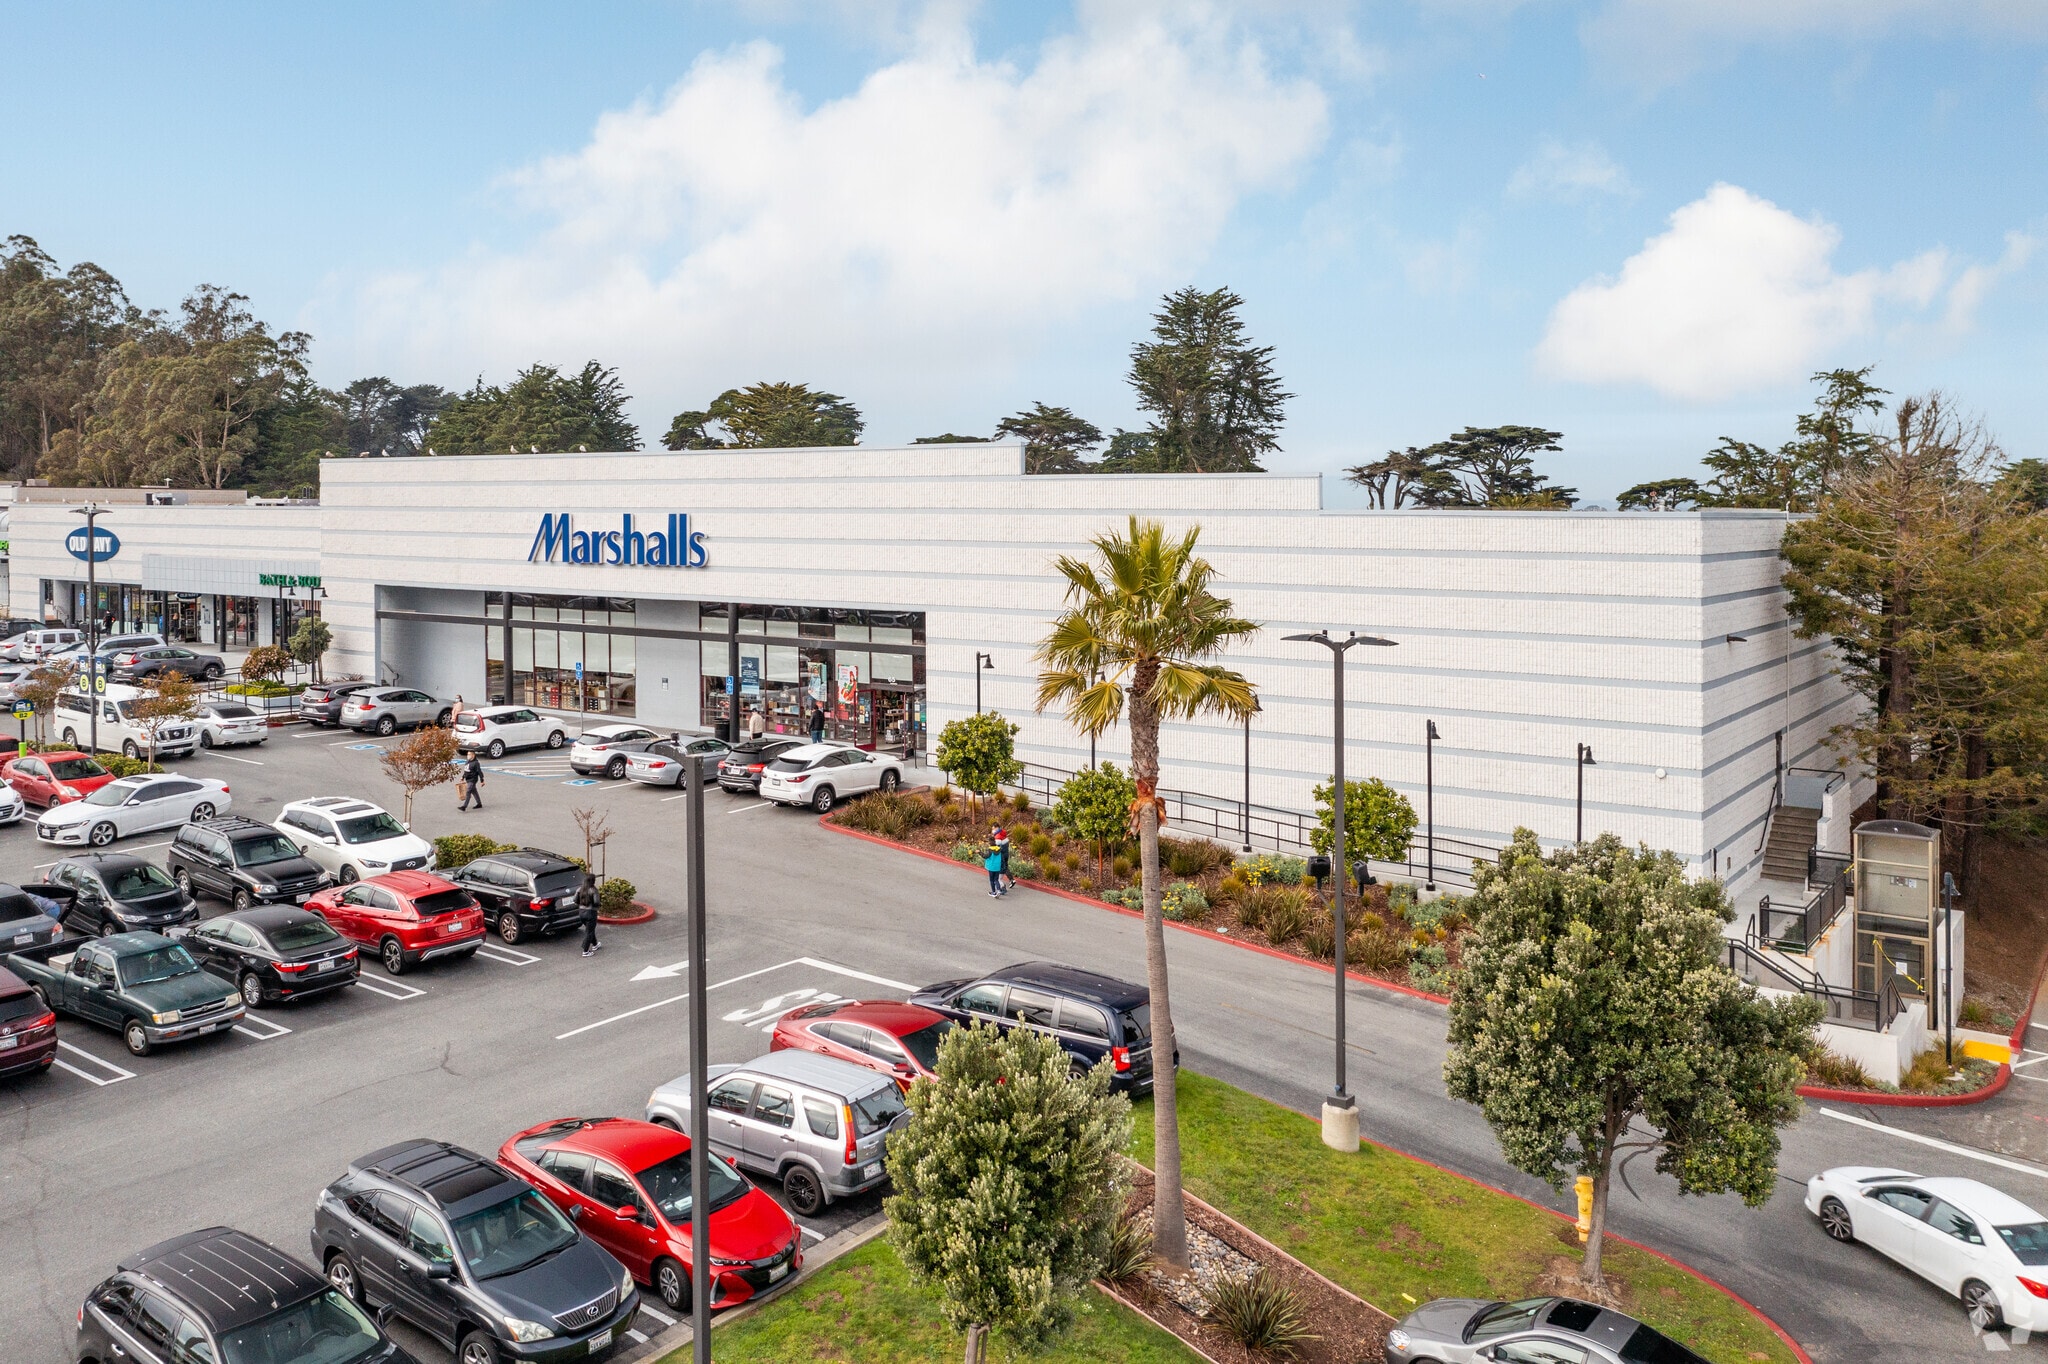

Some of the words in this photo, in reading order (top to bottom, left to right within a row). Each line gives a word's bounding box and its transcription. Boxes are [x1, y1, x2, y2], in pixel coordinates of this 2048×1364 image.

[69, 536, 87, 552] OLD
[91, 536, 112, 553] AVY
[527, 513, 708, 568] Marshalls
[259, 574, 287, 586] BATH
[287, 575, 297, 586] &
